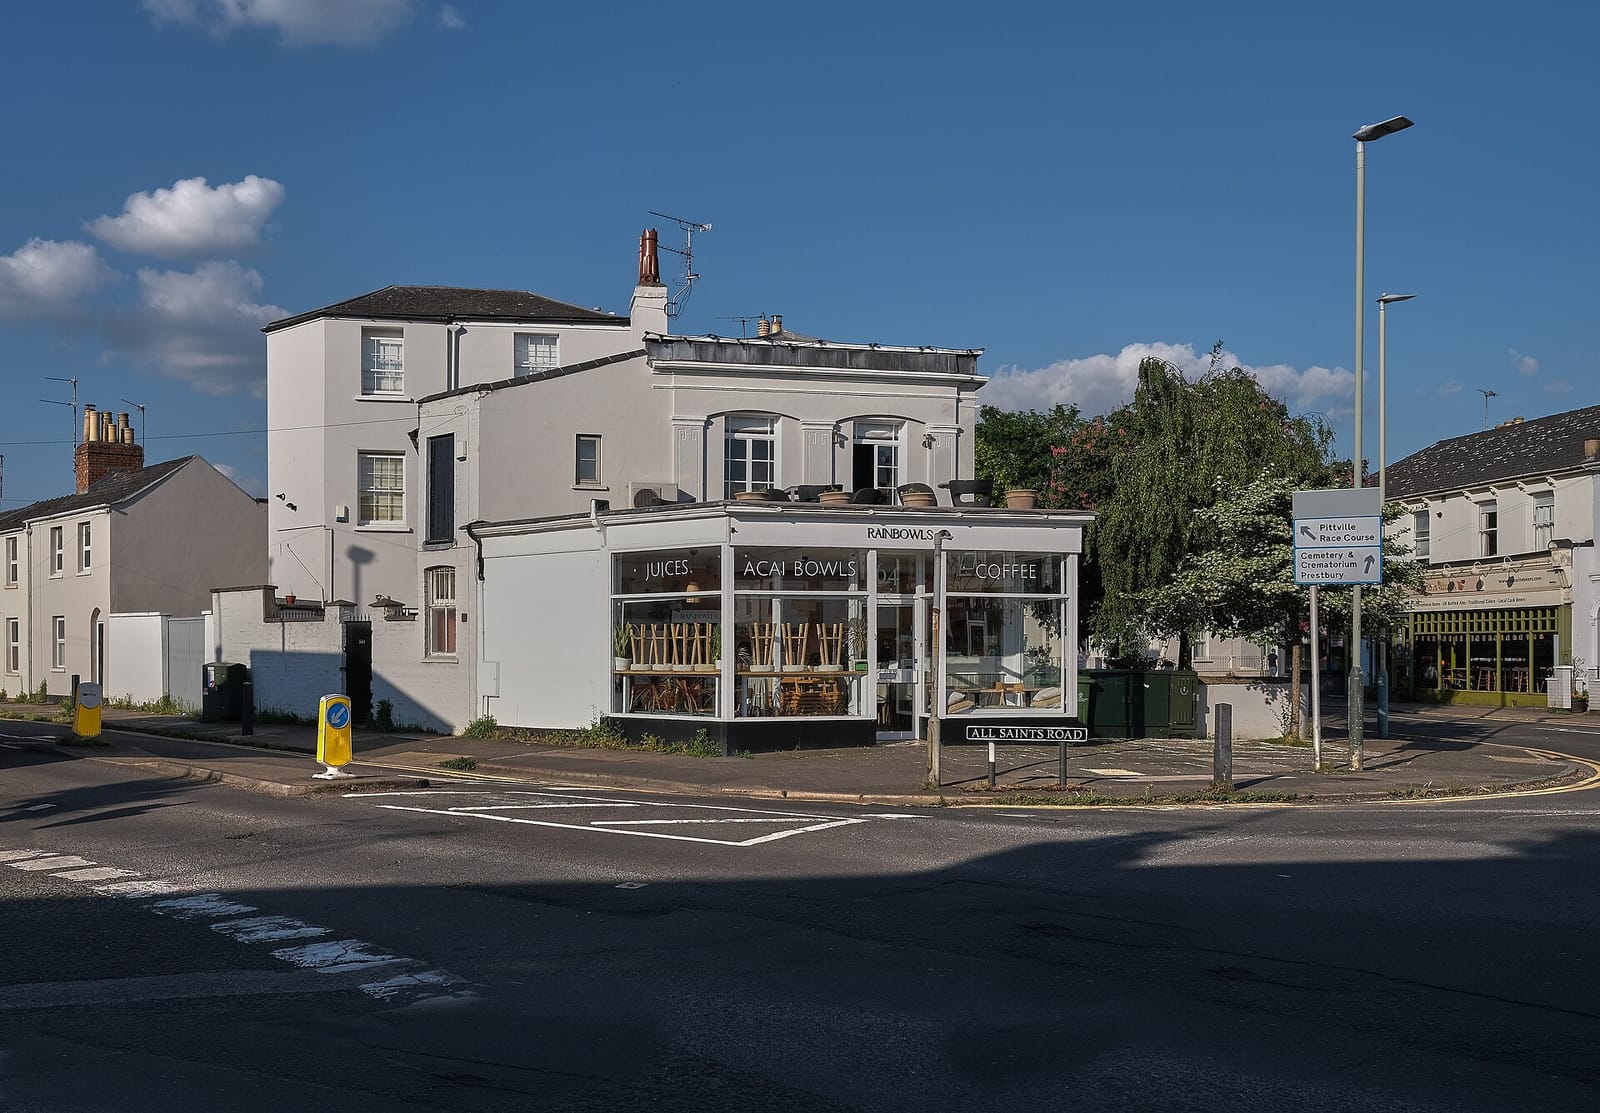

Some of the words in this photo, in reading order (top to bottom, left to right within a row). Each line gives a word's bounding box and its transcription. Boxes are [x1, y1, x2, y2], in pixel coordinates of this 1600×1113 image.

[1319, 523, 1356, 532] Pittville
[867, 527, 934, 541] RAINBOWLS
[1319, 534, 1341, 542] Race
[1343, 533, 1375, 542] Course
[1300, 551, 1343, 560] Cemetery
[645, 559, 689, 581] JUICES
[743, 561, 785, 577] ACAI
[794, 560, 856, 577] BOWLS
[1301, 561, 1358, 569] Crematorium
[976, 563, 1037, 579] COFFEE
[1301, 571, 1344, 580] Prestbury
[971, 728, 996, 738] ALL
[999, 728, 1044, 739] SAINTS
[1047, 729, 1083, 740] ROAD
